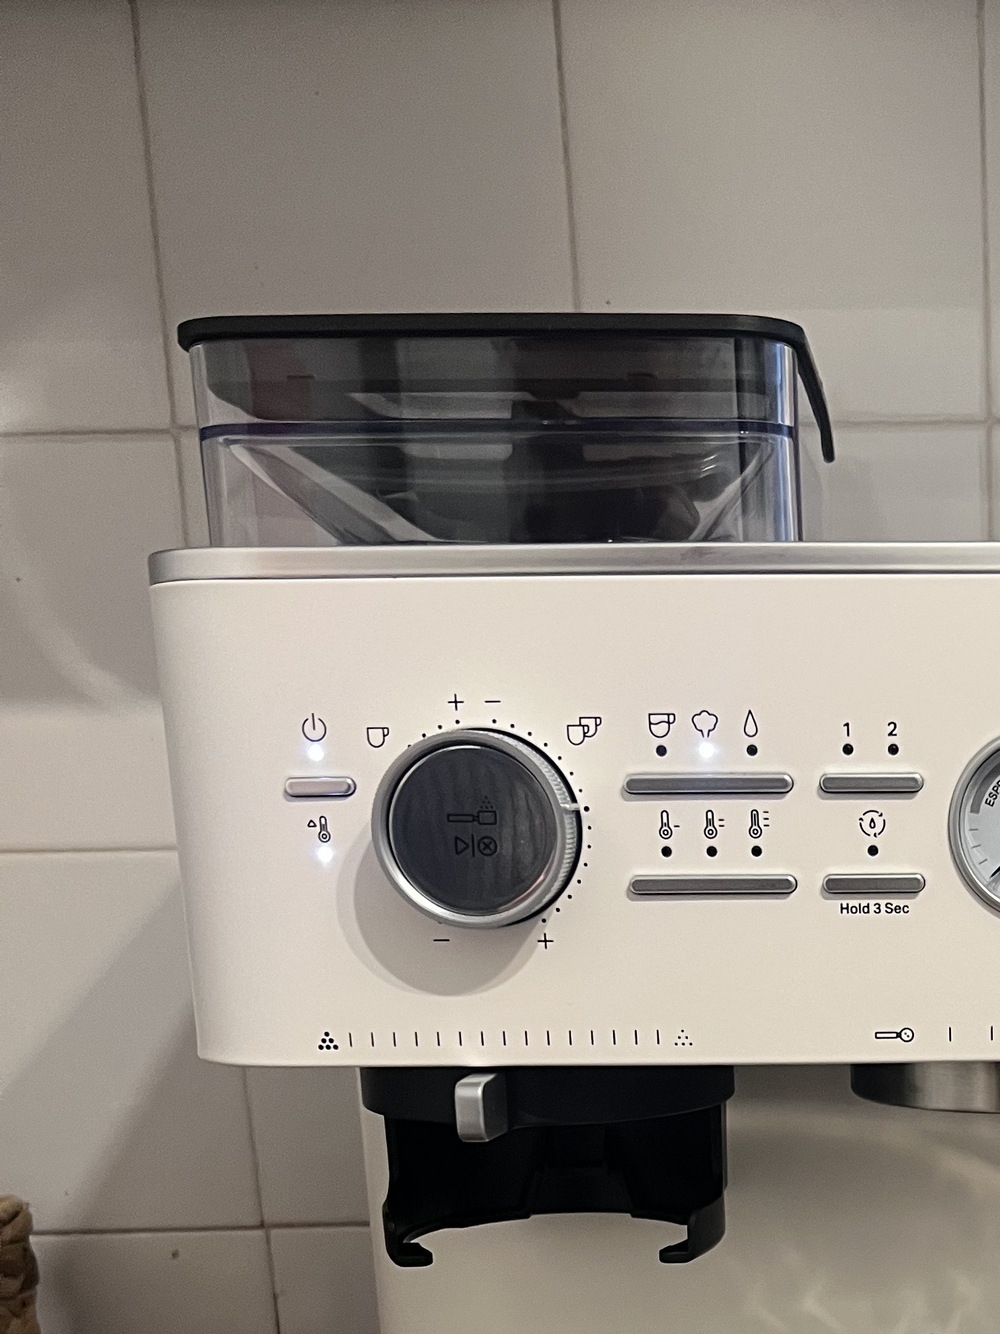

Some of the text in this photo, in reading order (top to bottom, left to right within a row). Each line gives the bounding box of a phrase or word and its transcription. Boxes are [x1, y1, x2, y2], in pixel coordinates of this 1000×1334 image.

[842, 721, 851, 737] 1
[887, 721, 898, 737] 2
[839, 901, 910, 915] Hold 3 Sec
